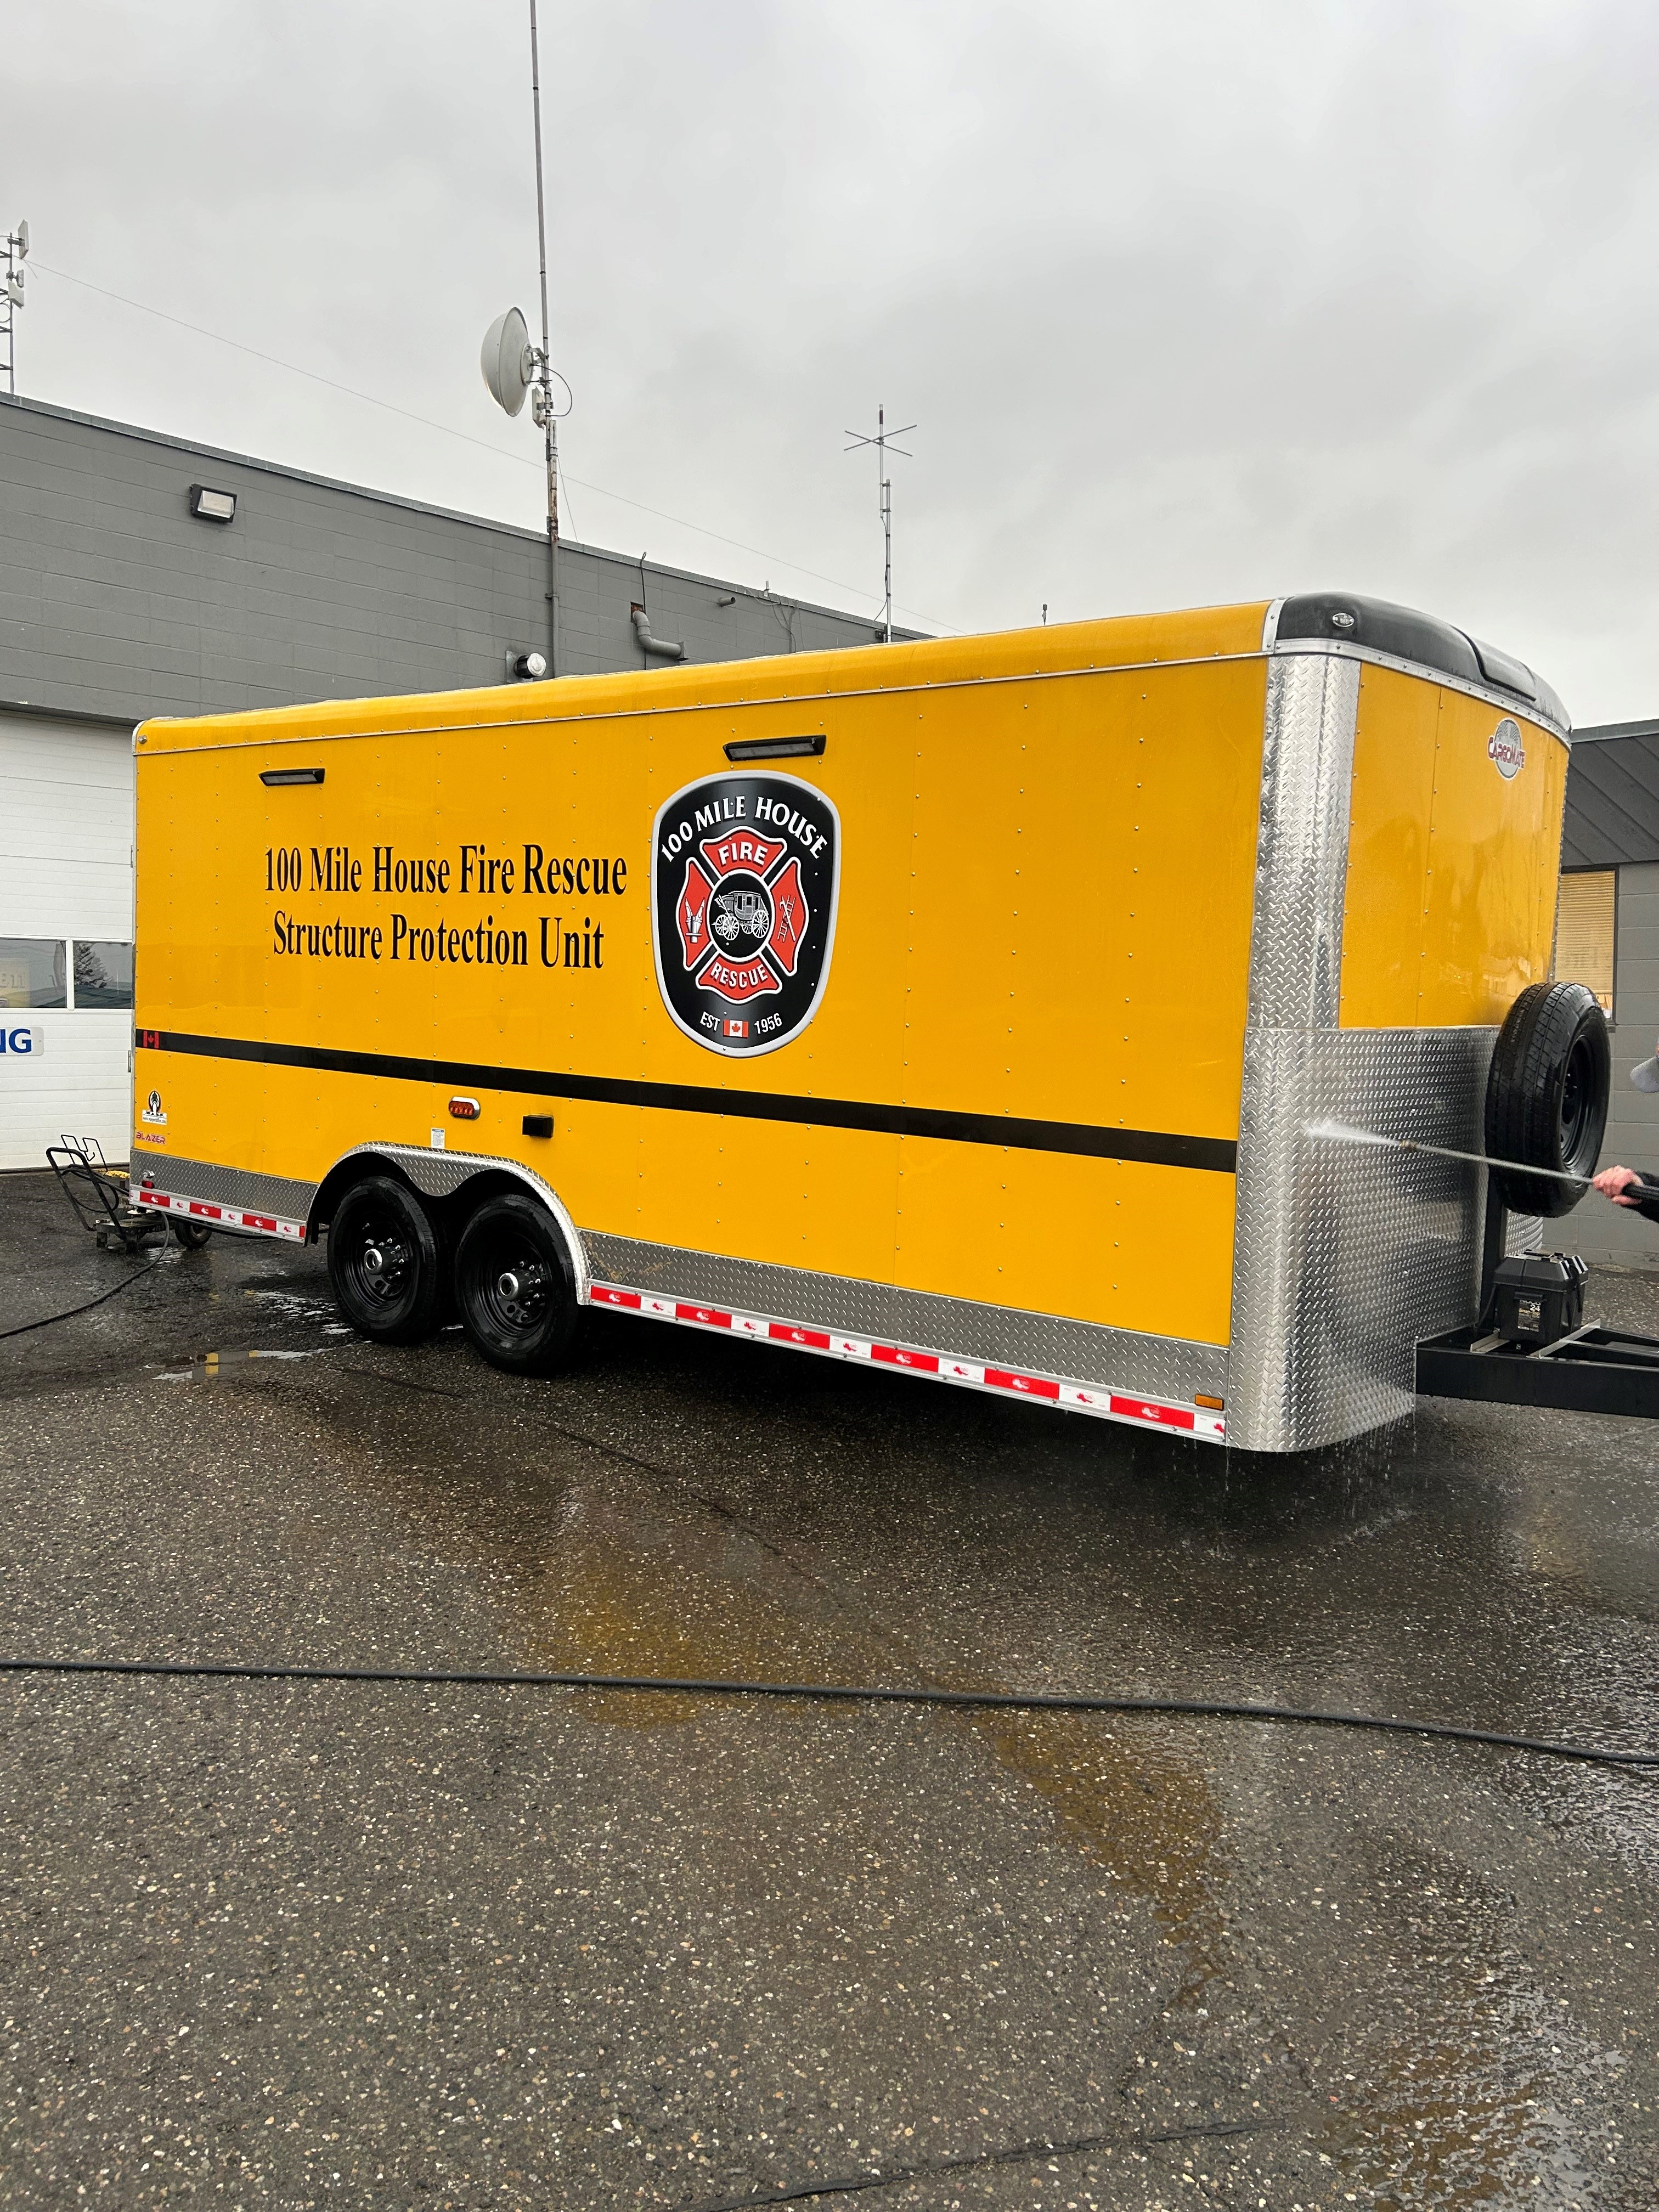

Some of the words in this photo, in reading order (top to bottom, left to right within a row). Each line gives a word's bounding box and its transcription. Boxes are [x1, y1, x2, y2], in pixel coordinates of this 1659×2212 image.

[662, 822, 693, 862] 100
[695, 796, 746, 832] MILE
[754, 797, 828, 859] HOUSE
[718, 842, 768, 866] FIRE
[265, 848, 301, 891] 100
[309, 847, 362, 892] Mile
[372, 847, 450, 894] House
[459, 844, 515, 894] Fire
[522, 844, 627, 895] Rescue
[274, 910, 382, 960] Structure
[390, 914, 528, 965] Protection
[538, 917, 604, 969] Unit
[711, 962, 768, 988] RESCUE
[700, 1012, 721, 1031] EST
[754, 1013, 782, 1034] 1956
[136, 1132, 166, 1144] BLAZER
